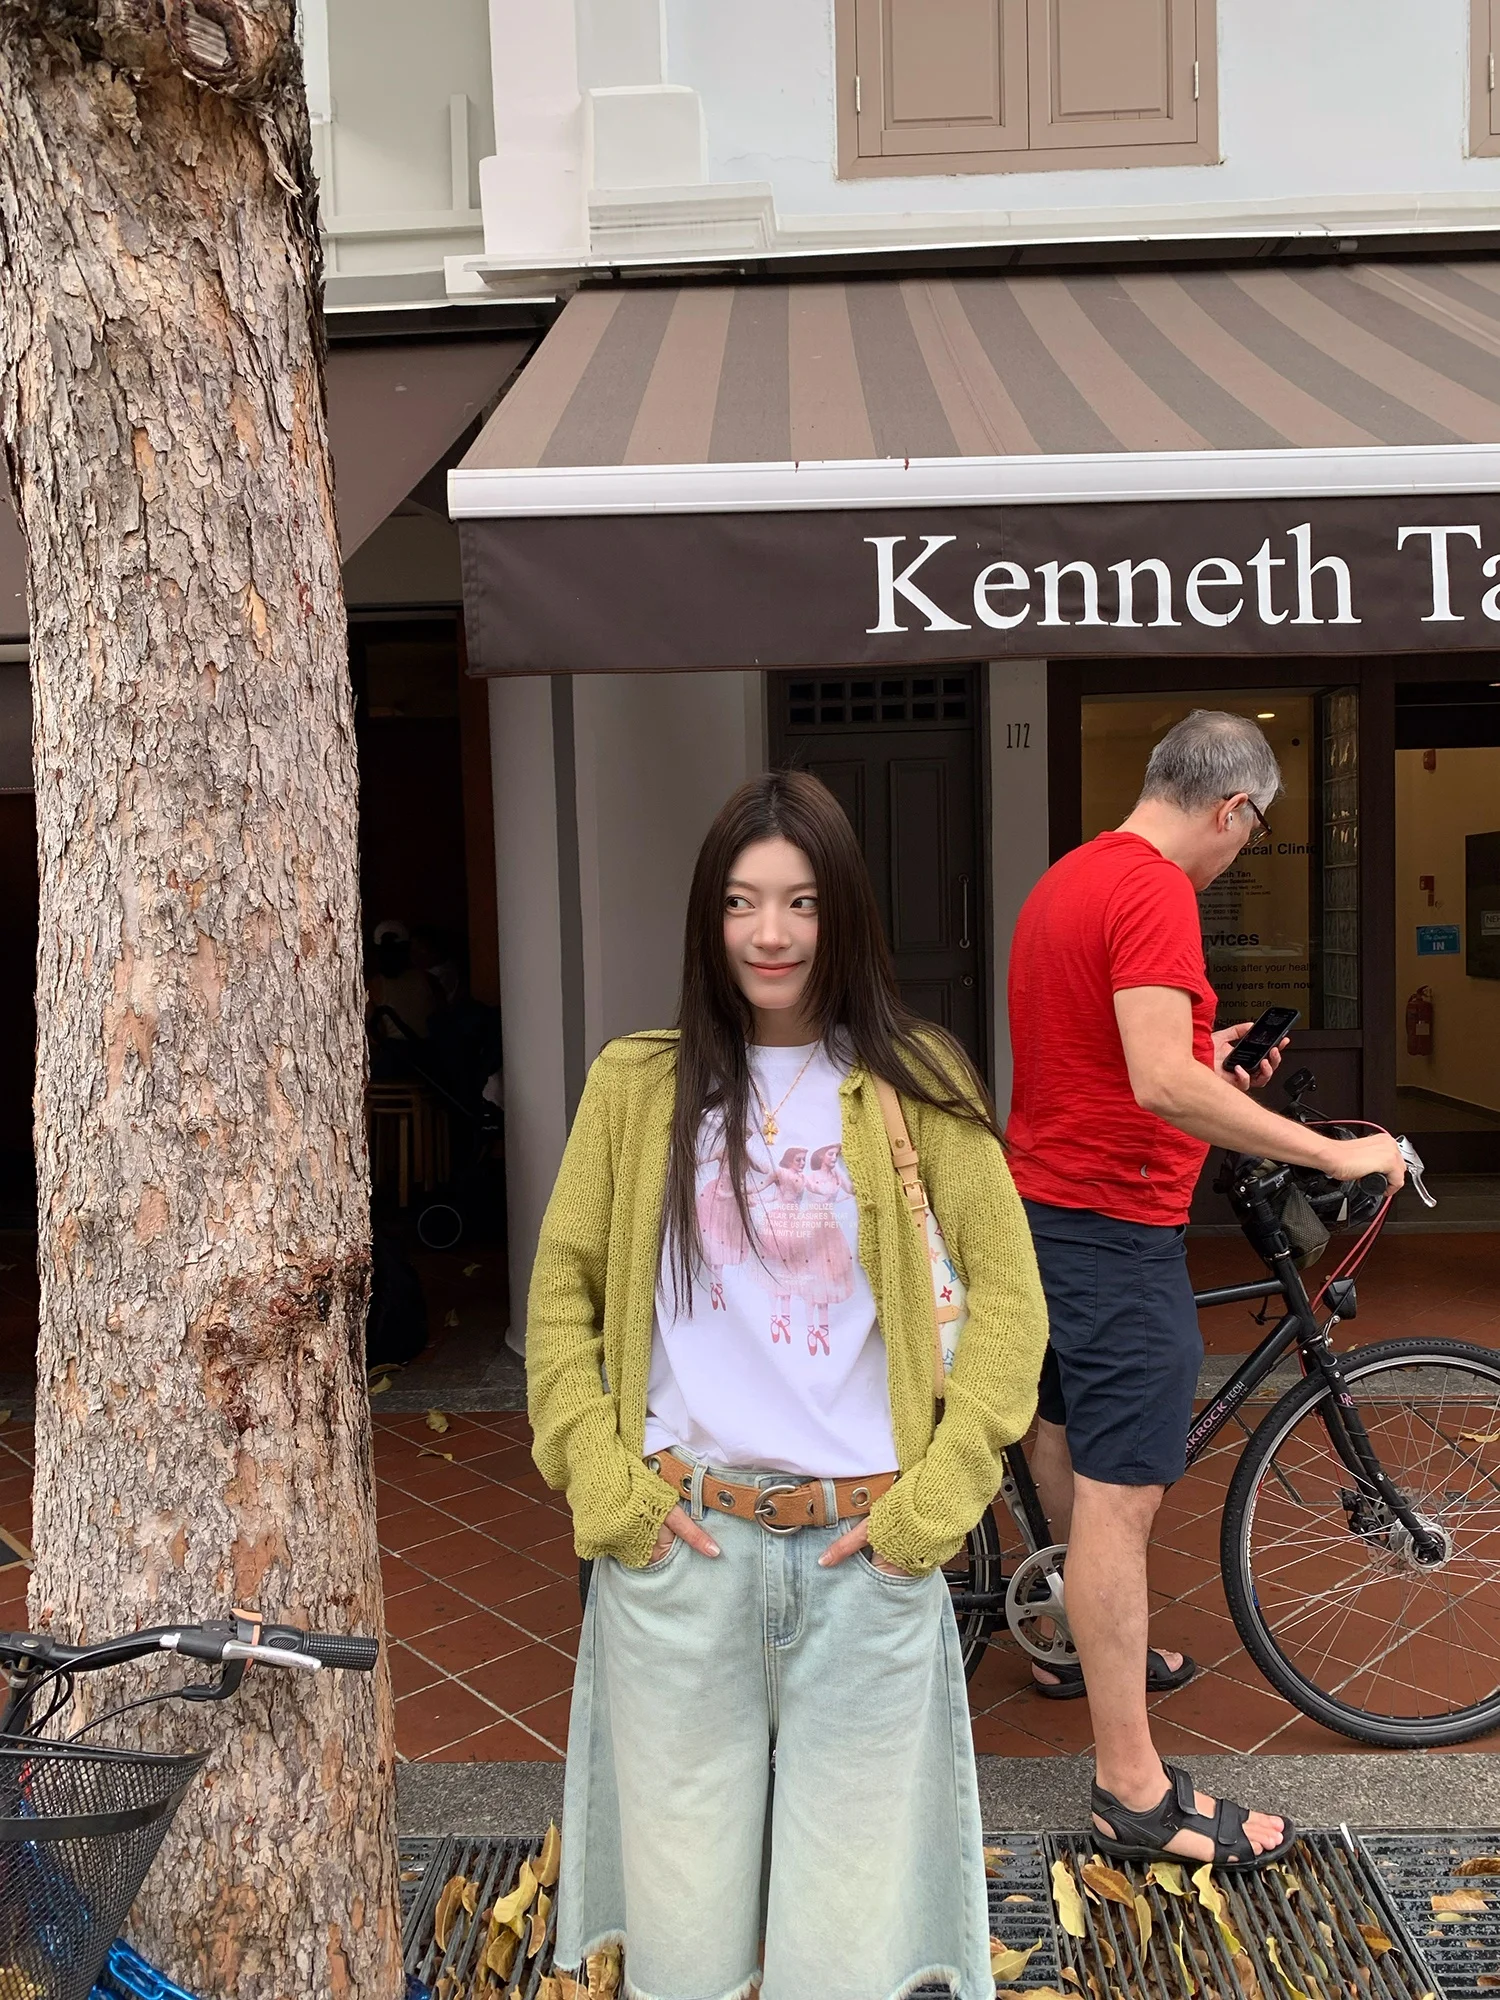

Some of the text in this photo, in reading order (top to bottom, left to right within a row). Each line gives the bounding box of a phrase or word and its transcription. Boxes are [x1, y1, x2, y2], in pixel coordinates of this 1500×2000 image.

[863, 523, 1363, 635] Kenneth
[1006, 722, 1031, 749] 172
[1236, 870, 1251, 878] Tan
[1202, 931, 1260, 946] rvices
[1432, 941, 1445, 951] IN
[1213, 963, 1238, 973] looks
[1240, 963, 1262, 973] after
[1264, 964, 1286, 973] your
[1214, 981, 1233, 990] and
[1236, 981, 1264, 991] years
[1267, 981, 1290, 989] from
[801, 1221, 822, 1229] FROM
[1225, 1380, 1246, 1402] TECH
